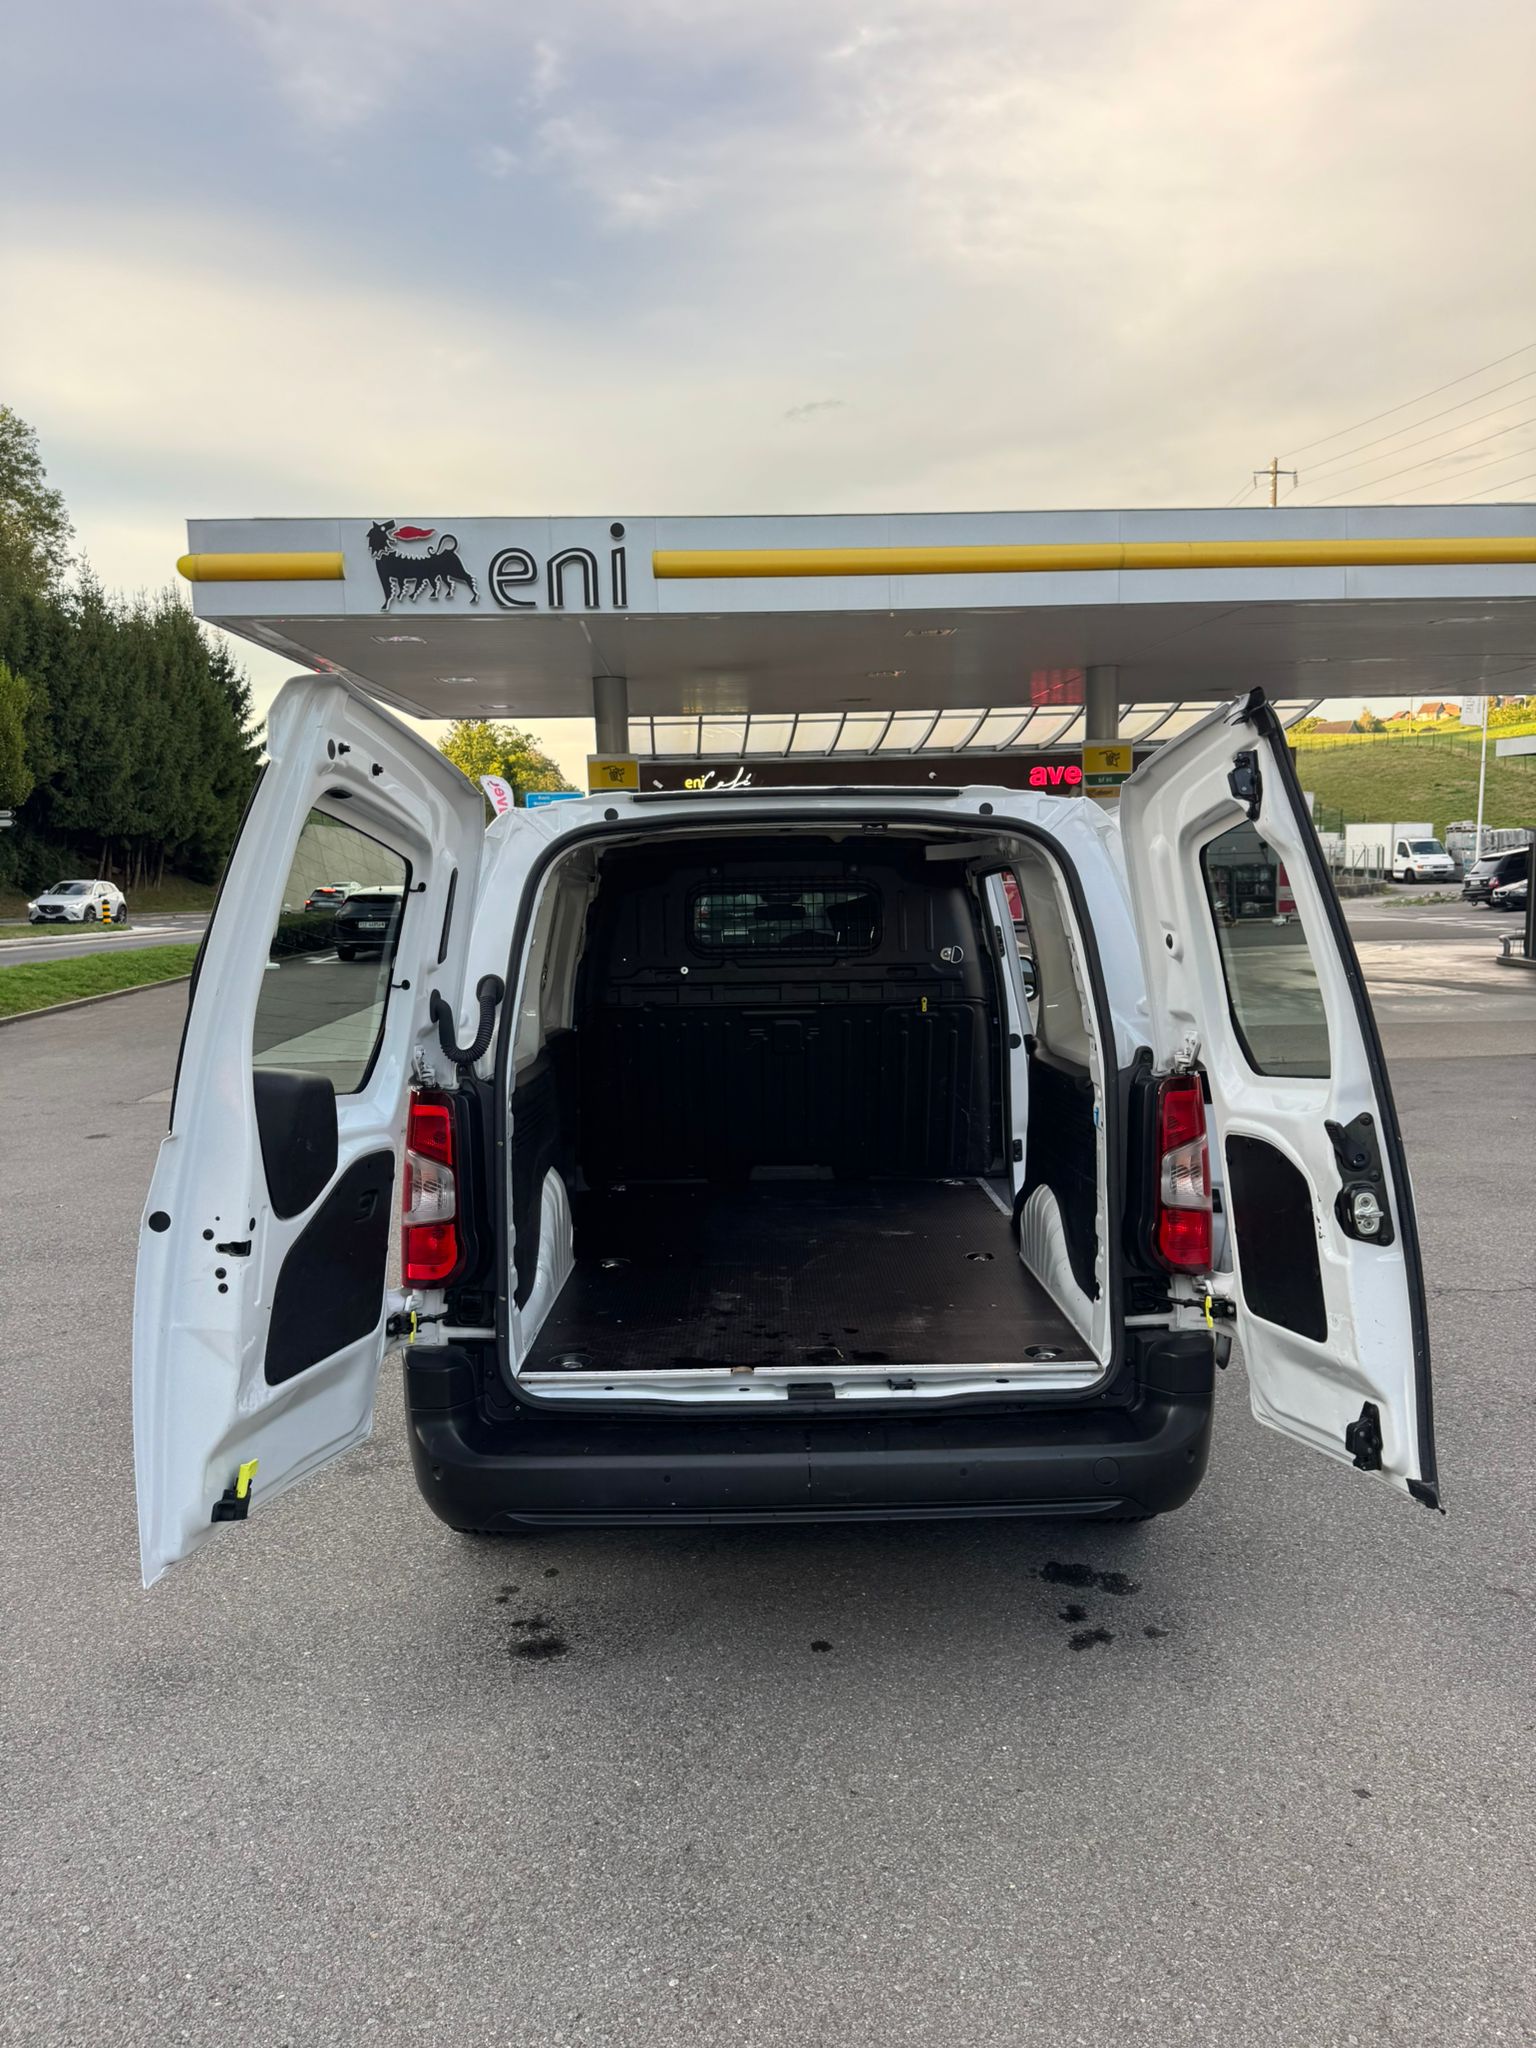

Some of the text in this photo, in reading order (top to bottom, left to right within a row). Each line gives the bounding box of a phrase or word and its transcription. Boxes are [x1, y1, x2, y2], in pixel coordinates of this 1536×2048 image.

[488, 522, 627, 608] eni
[684, 774, 705, 789] eni
[1029, 765, 1082, 786] ave
